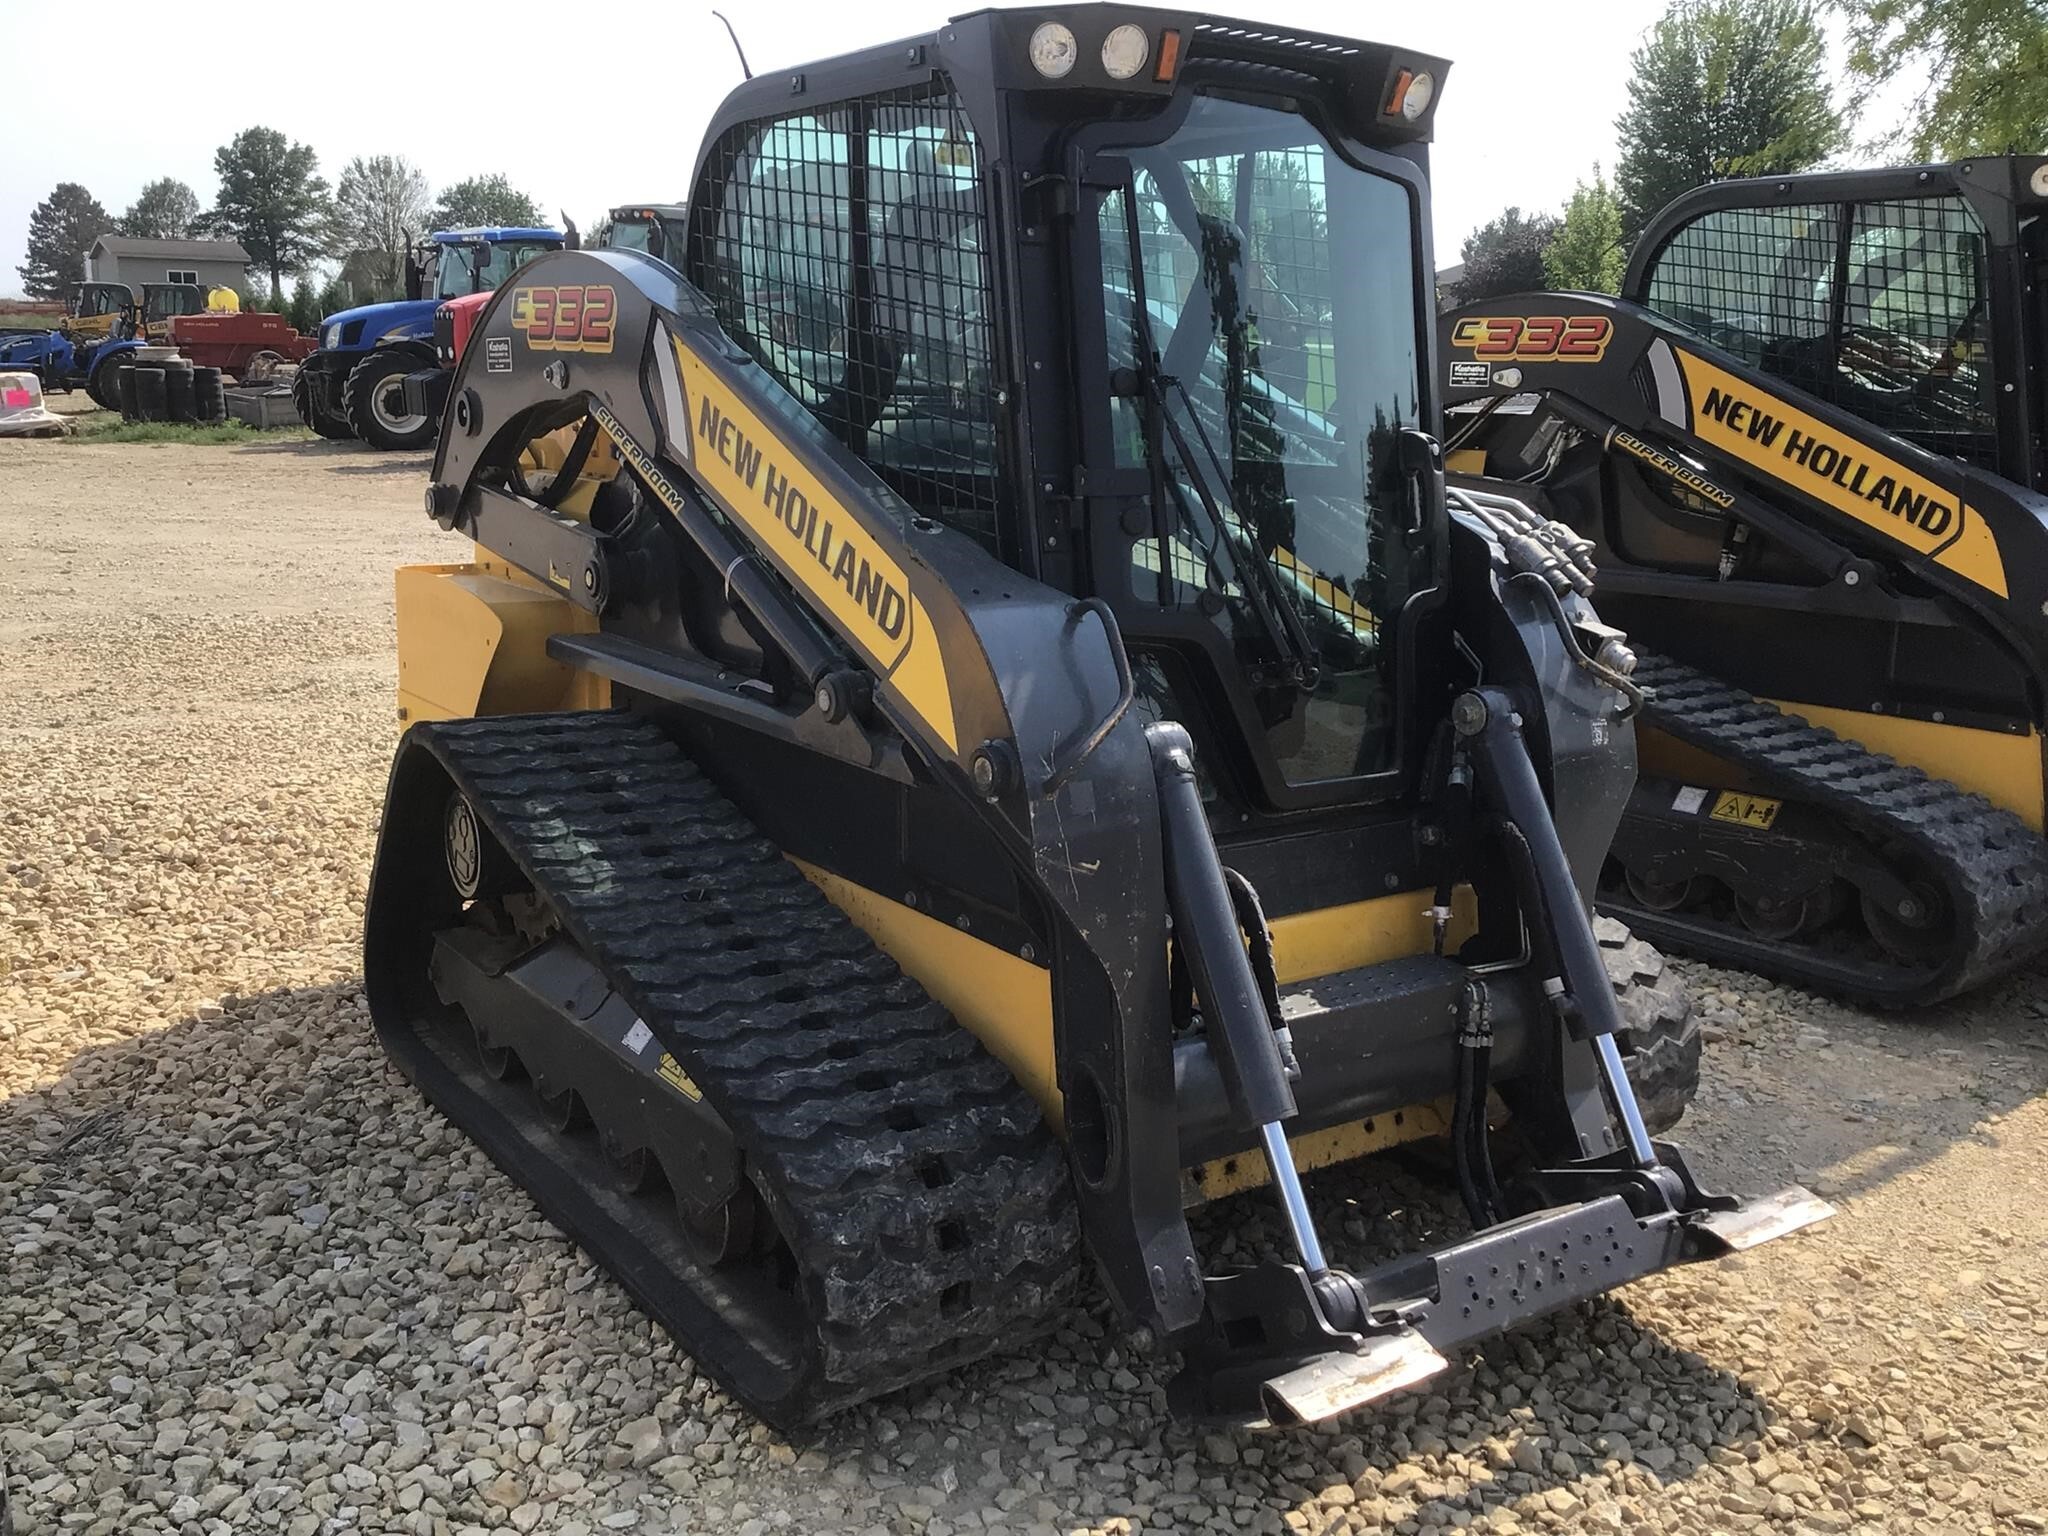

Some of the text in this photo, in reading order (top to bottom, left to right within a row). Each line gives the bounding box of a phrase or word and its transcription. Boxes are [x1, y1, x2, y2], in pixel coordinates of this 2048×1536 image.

[596, 406, 685, 515] SUPER BOOM
[698, 395, 907, 641] NEW HOLLAND
[1614, 431, 1734, 509] SUPER BOOM
[1701, 387, 1953, 537] NEW HOLLAND
